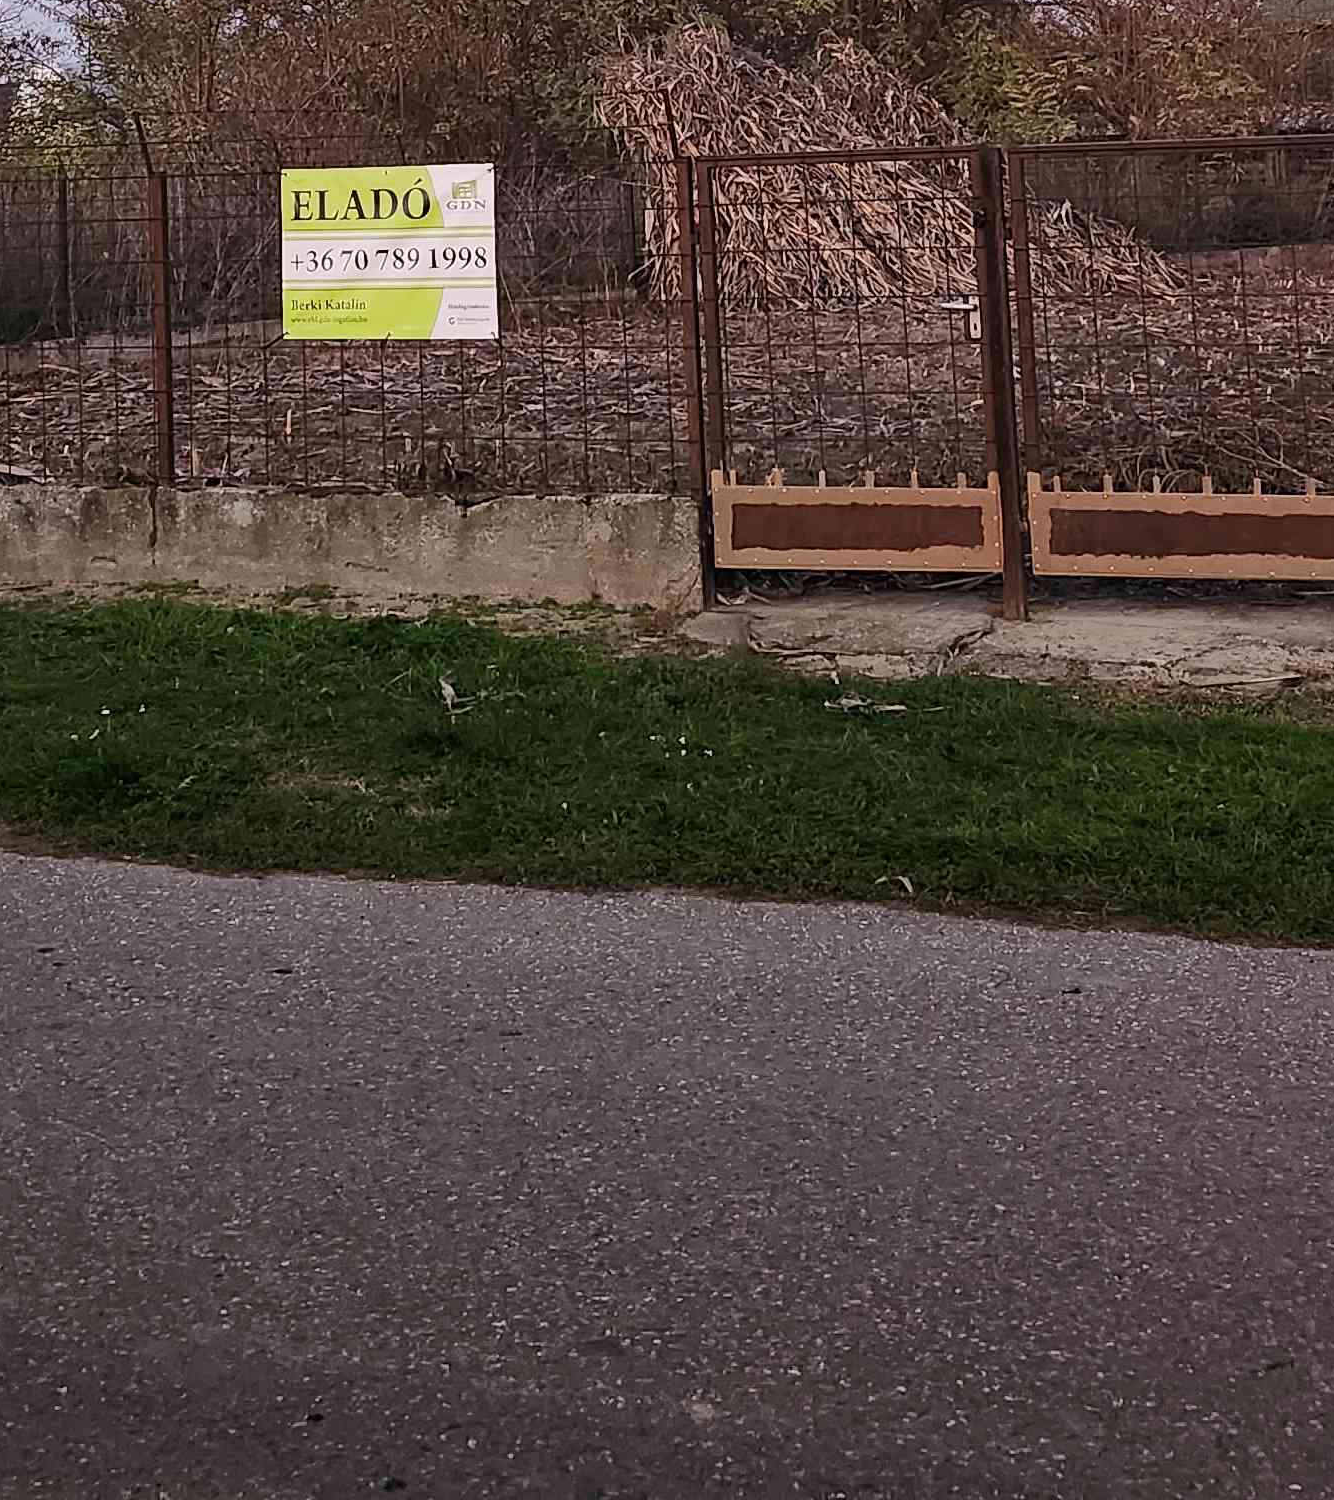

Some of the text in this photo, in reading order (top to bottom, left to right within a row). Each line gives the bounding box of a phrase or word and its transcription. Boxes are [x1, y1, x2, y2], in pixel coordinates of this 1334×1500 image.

[290, 178, 431, 222] ELADÓ
[446, 199, 486, 211] GDN
[290, 246, 488, 273] +36 70 789 1998
[290, 298, 367, 311] Berki Katalin
